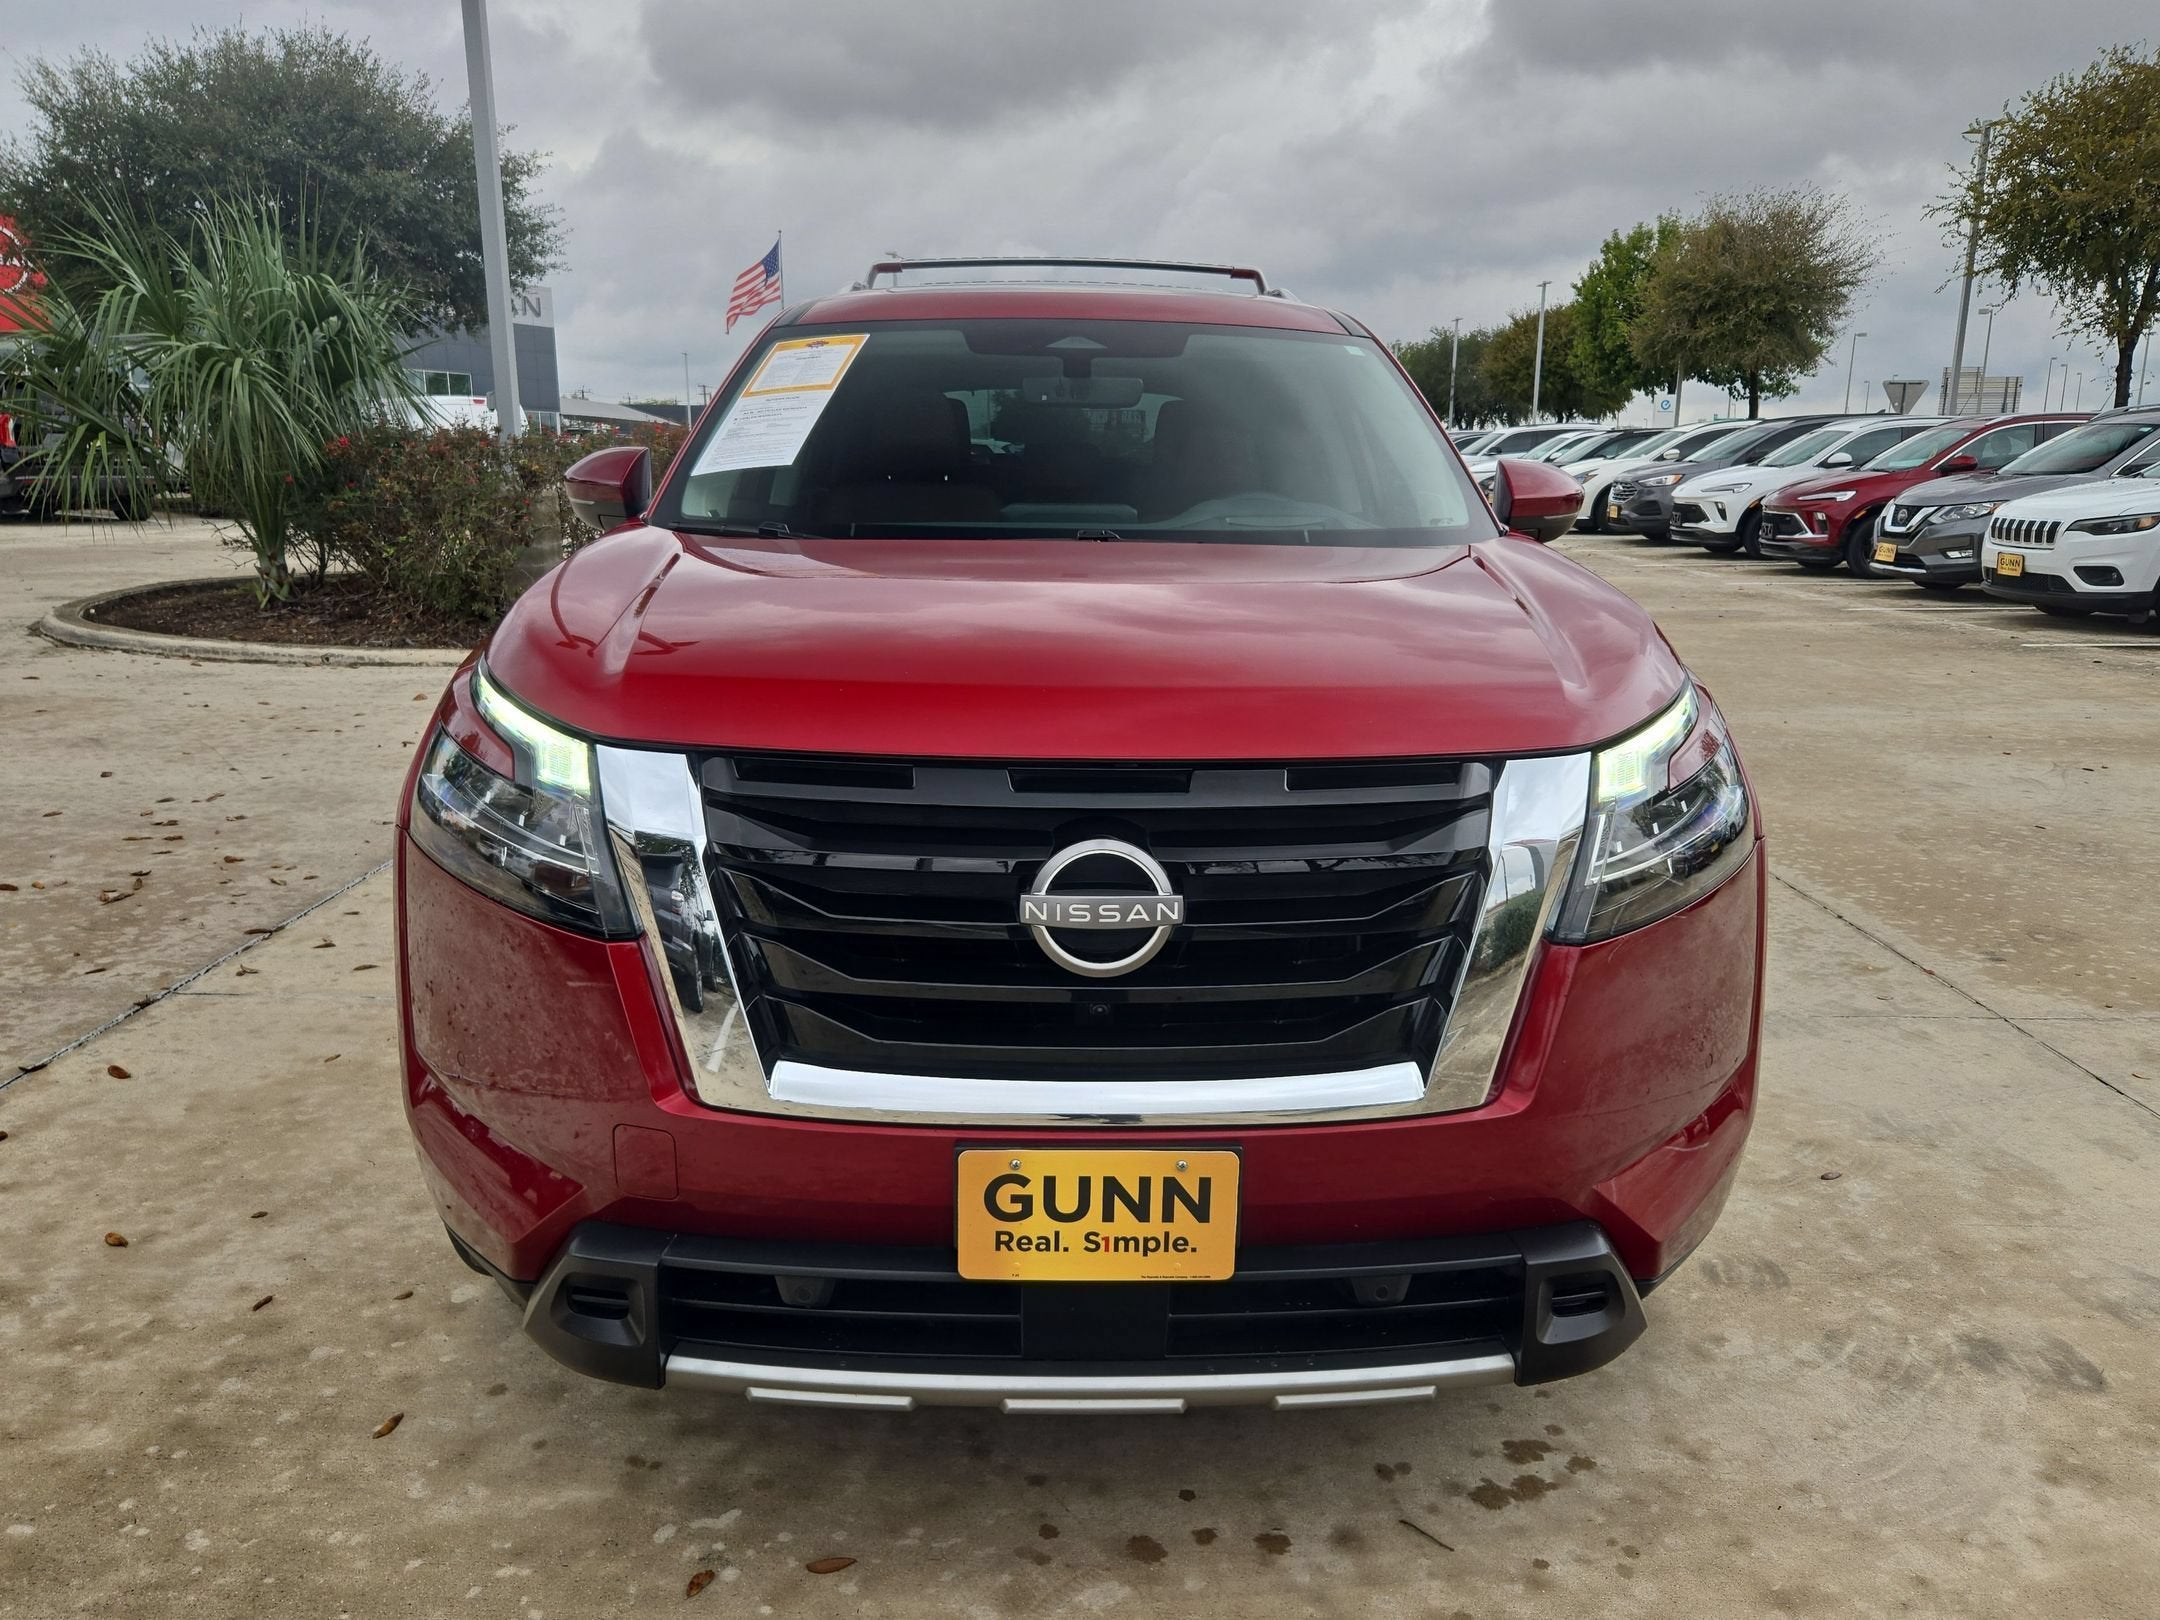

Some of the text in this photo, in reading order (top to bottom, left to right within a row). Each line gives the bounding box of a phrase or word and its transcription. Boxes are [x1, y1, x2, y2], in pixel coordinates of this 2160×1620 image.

[2000, 557, 2021, 567] GUNN
[1024, 901, 1179, 923] NISSAN
[983, 1173, 1212, 1223] GUNN
[995, 1231, 1069, 1252] Real.
